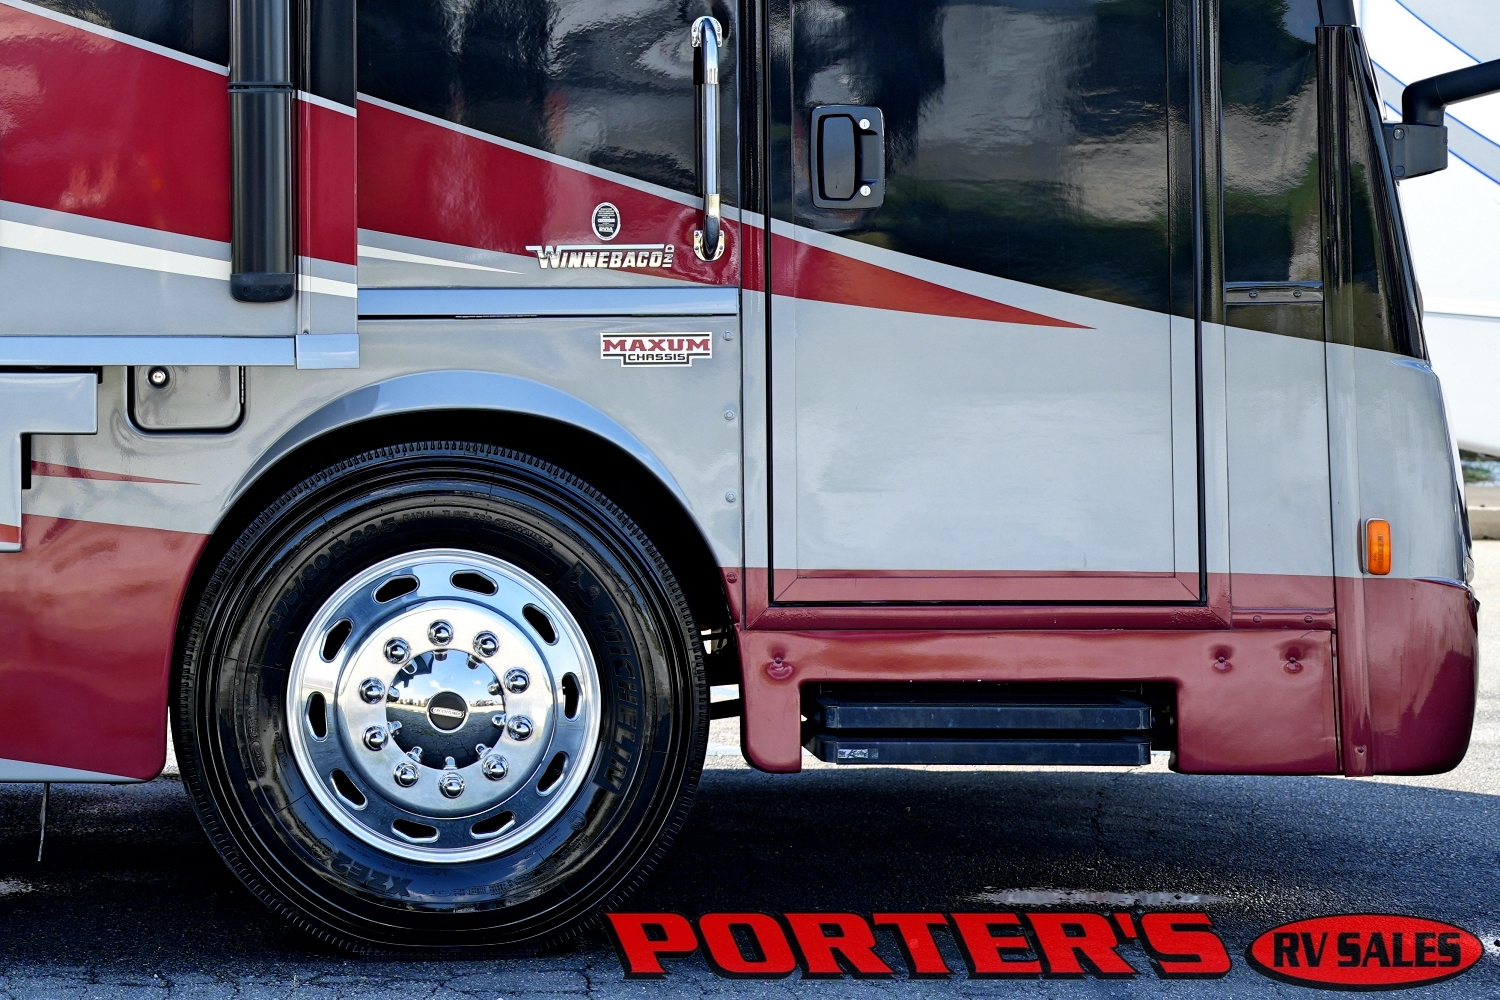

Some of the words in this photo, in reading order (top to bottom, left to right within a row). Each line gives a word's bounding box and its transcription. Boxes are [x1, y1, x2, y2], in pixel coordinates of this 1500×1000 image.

[526, 244, 664, 269] WINNEBAGO
[602, 338, 711, 352] MAXUM
[627, 353, 686, 361] CHASSIS
[594, 611, 638, 791] MICHELIN
